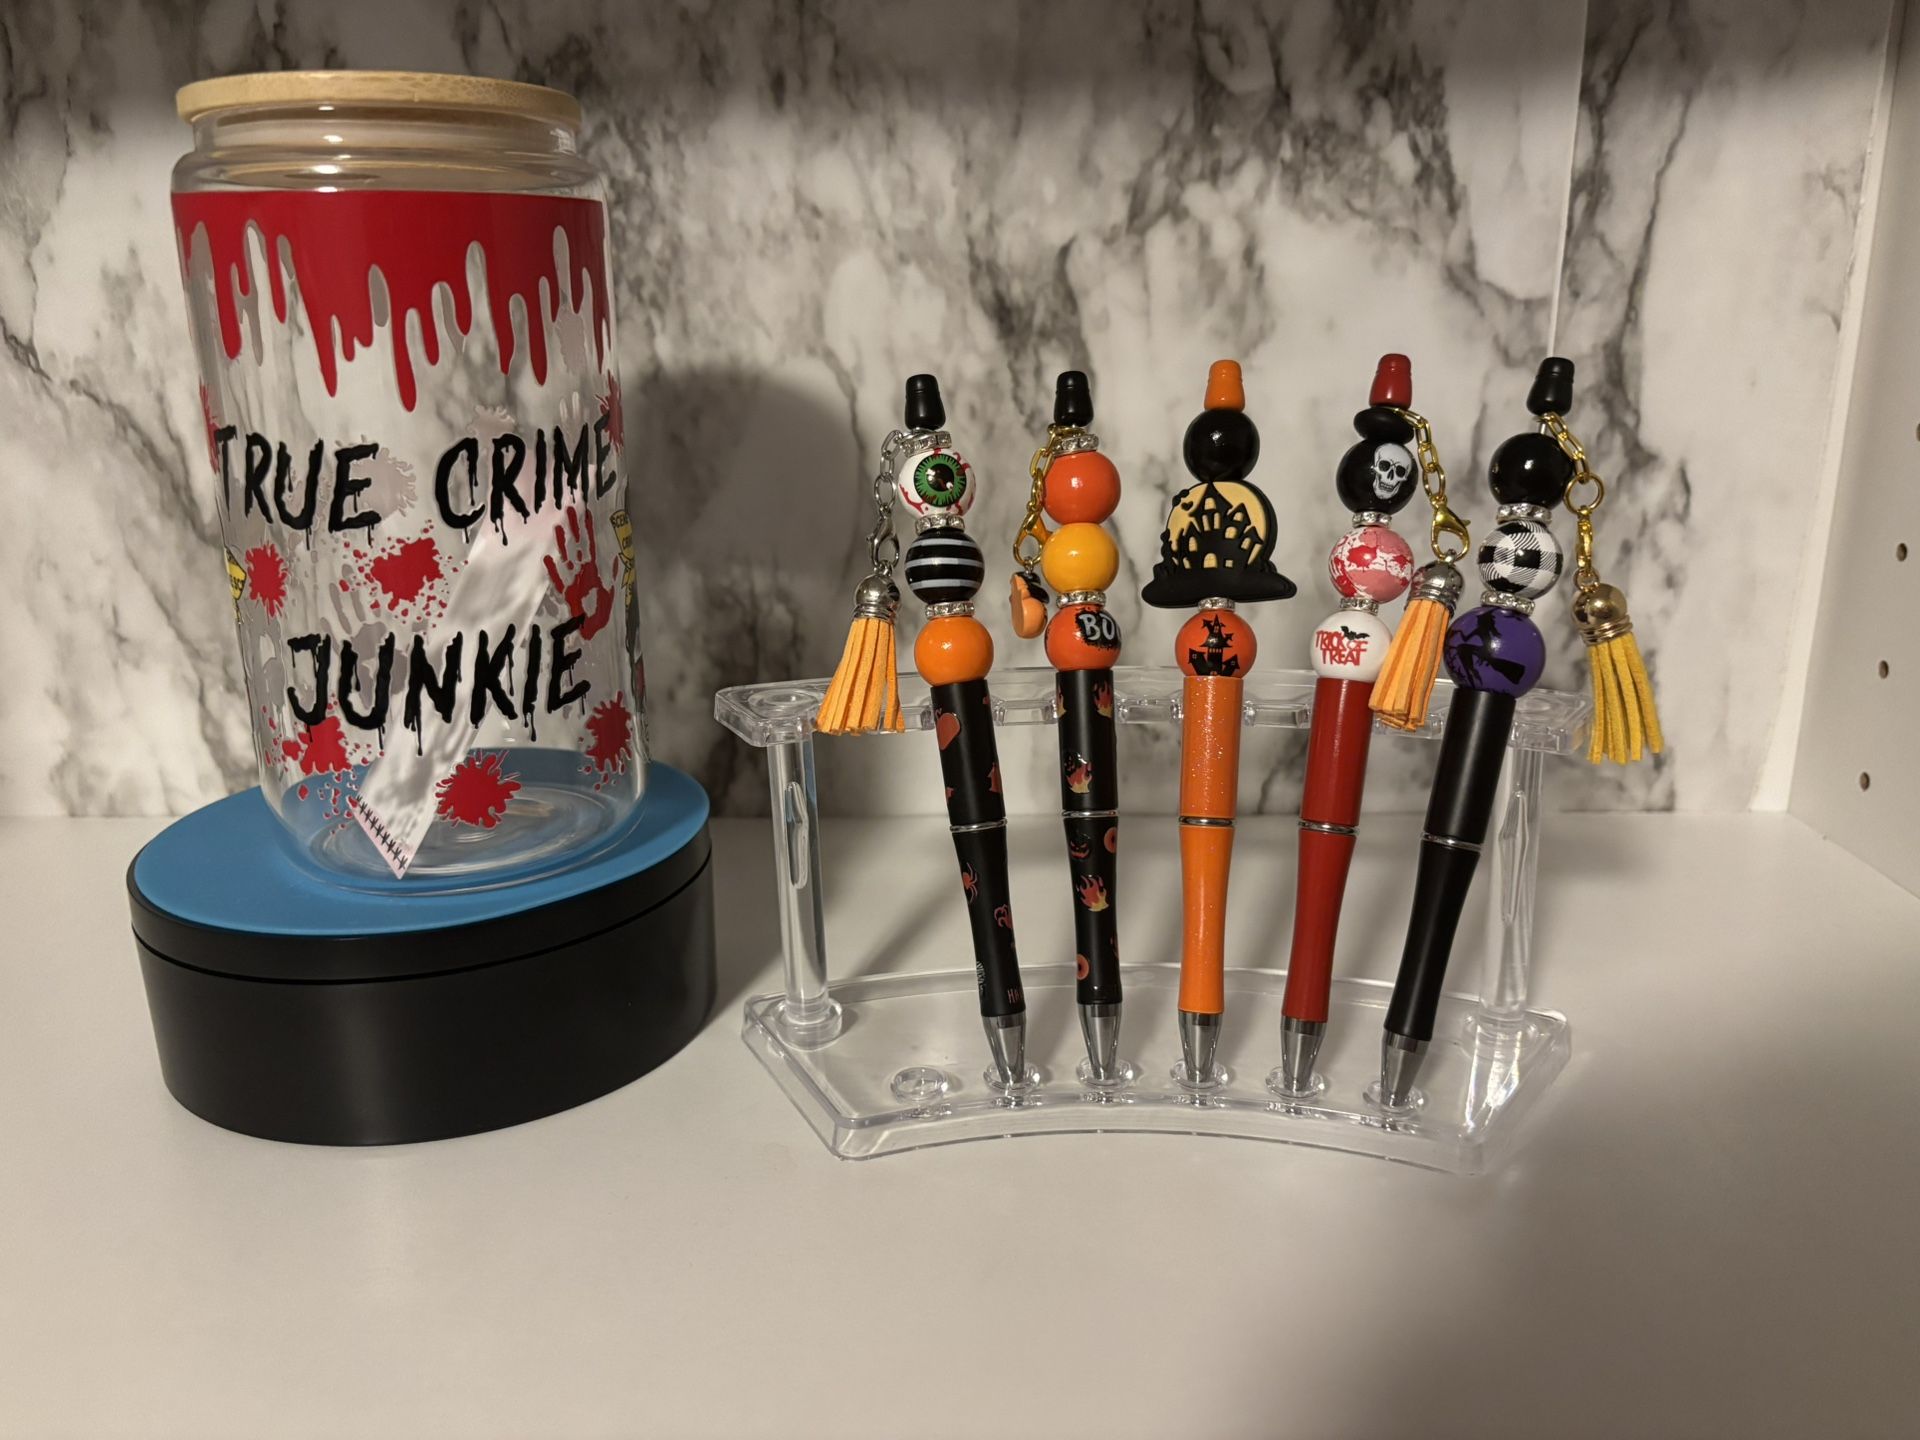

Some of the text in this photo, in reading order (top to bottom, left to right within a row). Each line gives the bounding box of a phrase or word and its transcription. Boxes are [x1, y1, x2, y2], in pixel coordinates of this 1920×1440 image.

[214, 410, 616, 550] TRUE CRIME
[1079, 612, 1121, 640] BO
[1316, 630, 1346, 651] TRICK
[1322, 648, 1360, 666] TREAT
[287, 613, 592, 756] JUNKIE
